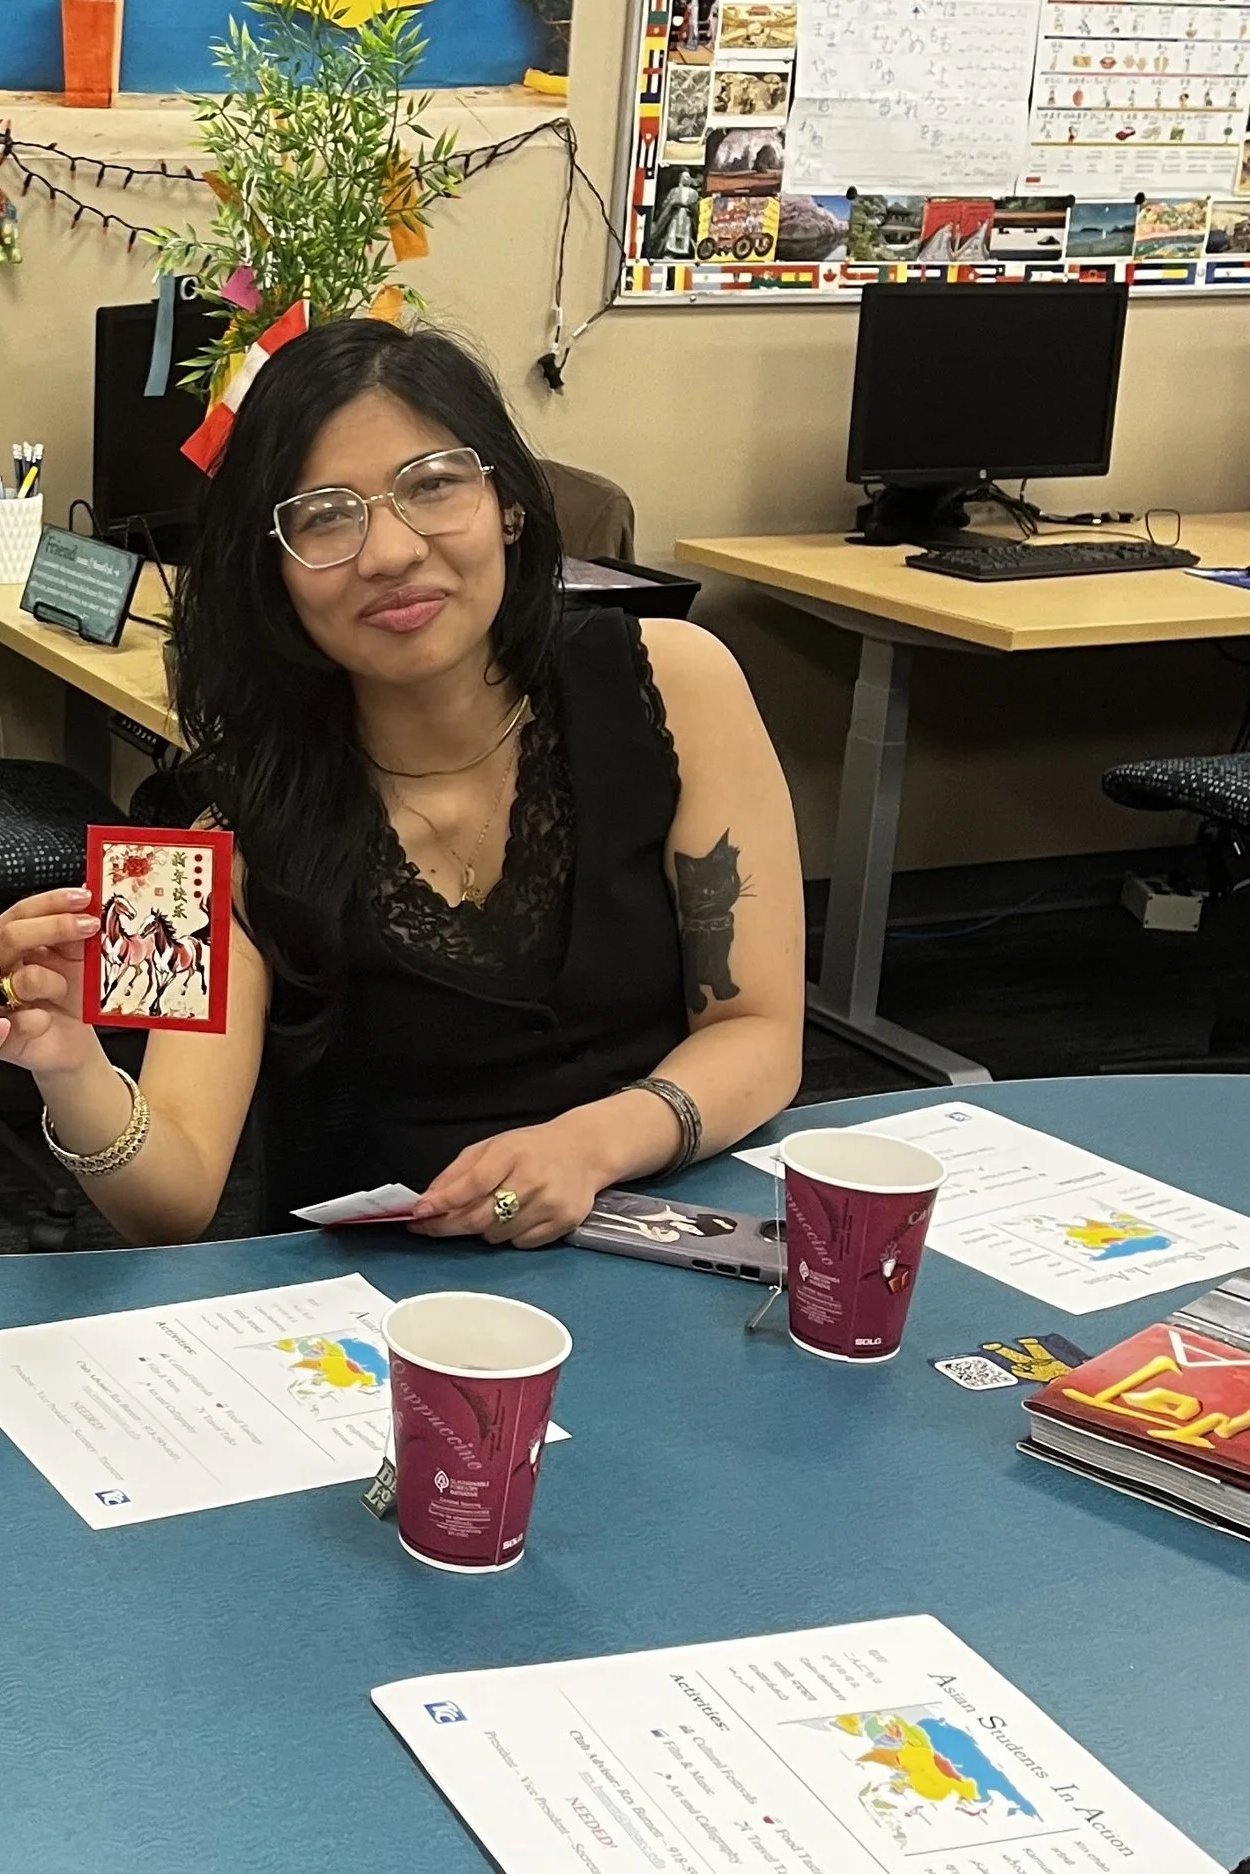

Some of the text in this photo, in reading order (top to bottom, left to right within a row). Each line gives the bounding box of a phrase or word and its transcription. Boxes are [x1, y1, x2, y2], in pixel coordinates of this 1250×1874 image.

[855, 1336, 882, 1346] SOLO
[668, 1672, 731, 1732] Activities:
[483, 1730, 518, 1769] President
[520, 1776, 538, 1797] Vice
[534, 1796, 571, 1836] President
[568, 1729, 591, 1752] Club
[588, 1753, 621, 1788] Advisor:
[616, 1788, 635, 1806] Rex
[662, 1738, 684, 1761] Film
[689, 1770, 716, 1797] Music
[746, 1833, 780, 1864] Travel
[691, 1735, 728, 1770] Cultural
[774, 1828, 804, 1852] Food
[926, 1669, 1135, 1858] Asian Students In Action
[564, 1796, 618, 1849] NEEDED!
[666, 1784, 743, 1866] Art and Calligraphy
